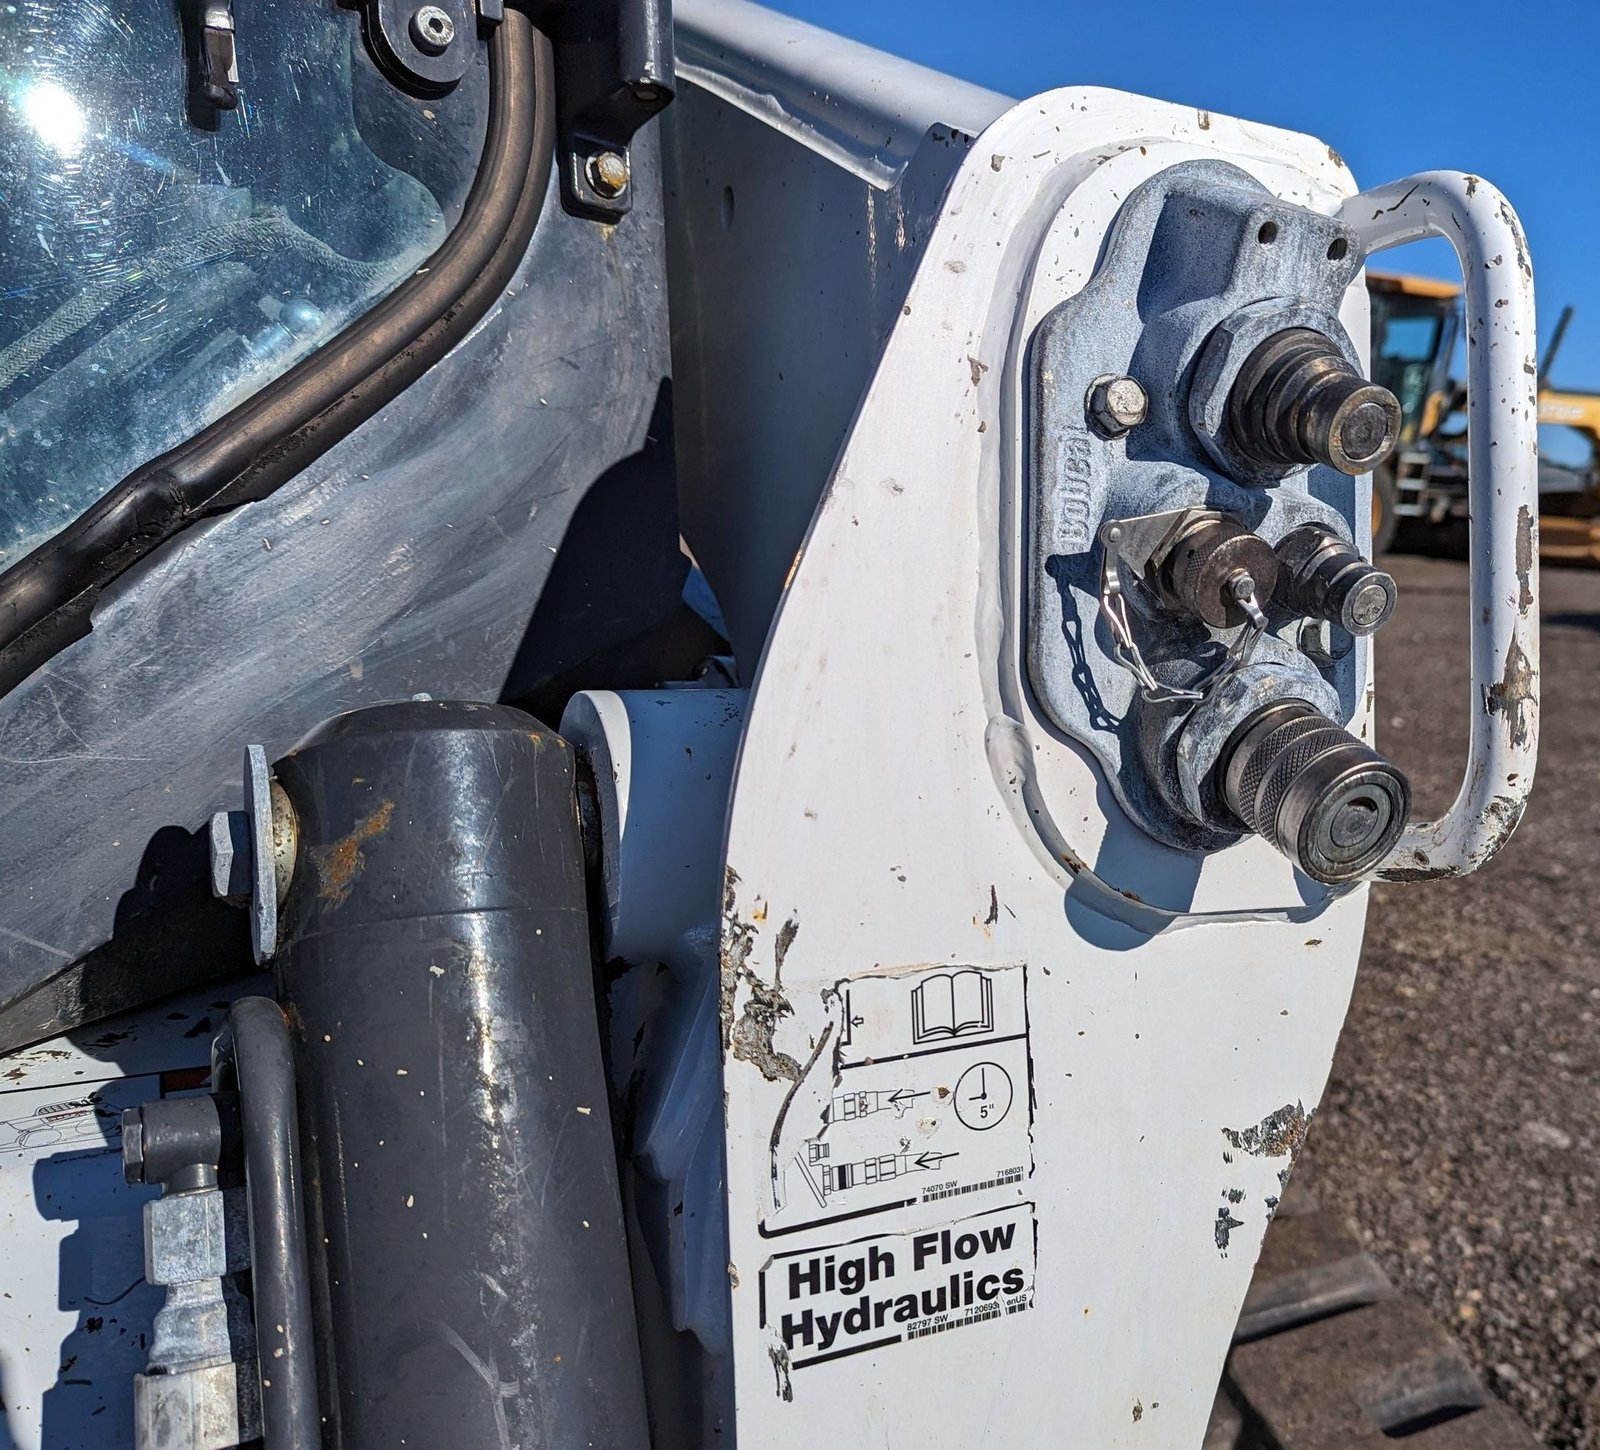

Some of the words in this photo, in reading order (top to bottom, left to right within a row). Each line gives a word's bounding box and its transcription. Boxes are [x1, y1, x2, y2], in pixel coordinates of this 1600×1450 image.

[921, 1183, 944, 1195] 74070
[945, 1180, 959, 1190] SW
[996, 1166, 1024, 1178] 7168031
[788, 1245, 895, 1301] High
[912, 1222, 1017, 1272] Flow
[781, 1267, 1025, 1351] Hydraulics
[906, 1318, 932, 1332] 82797
[934, 1313, 949, 1325] SW
